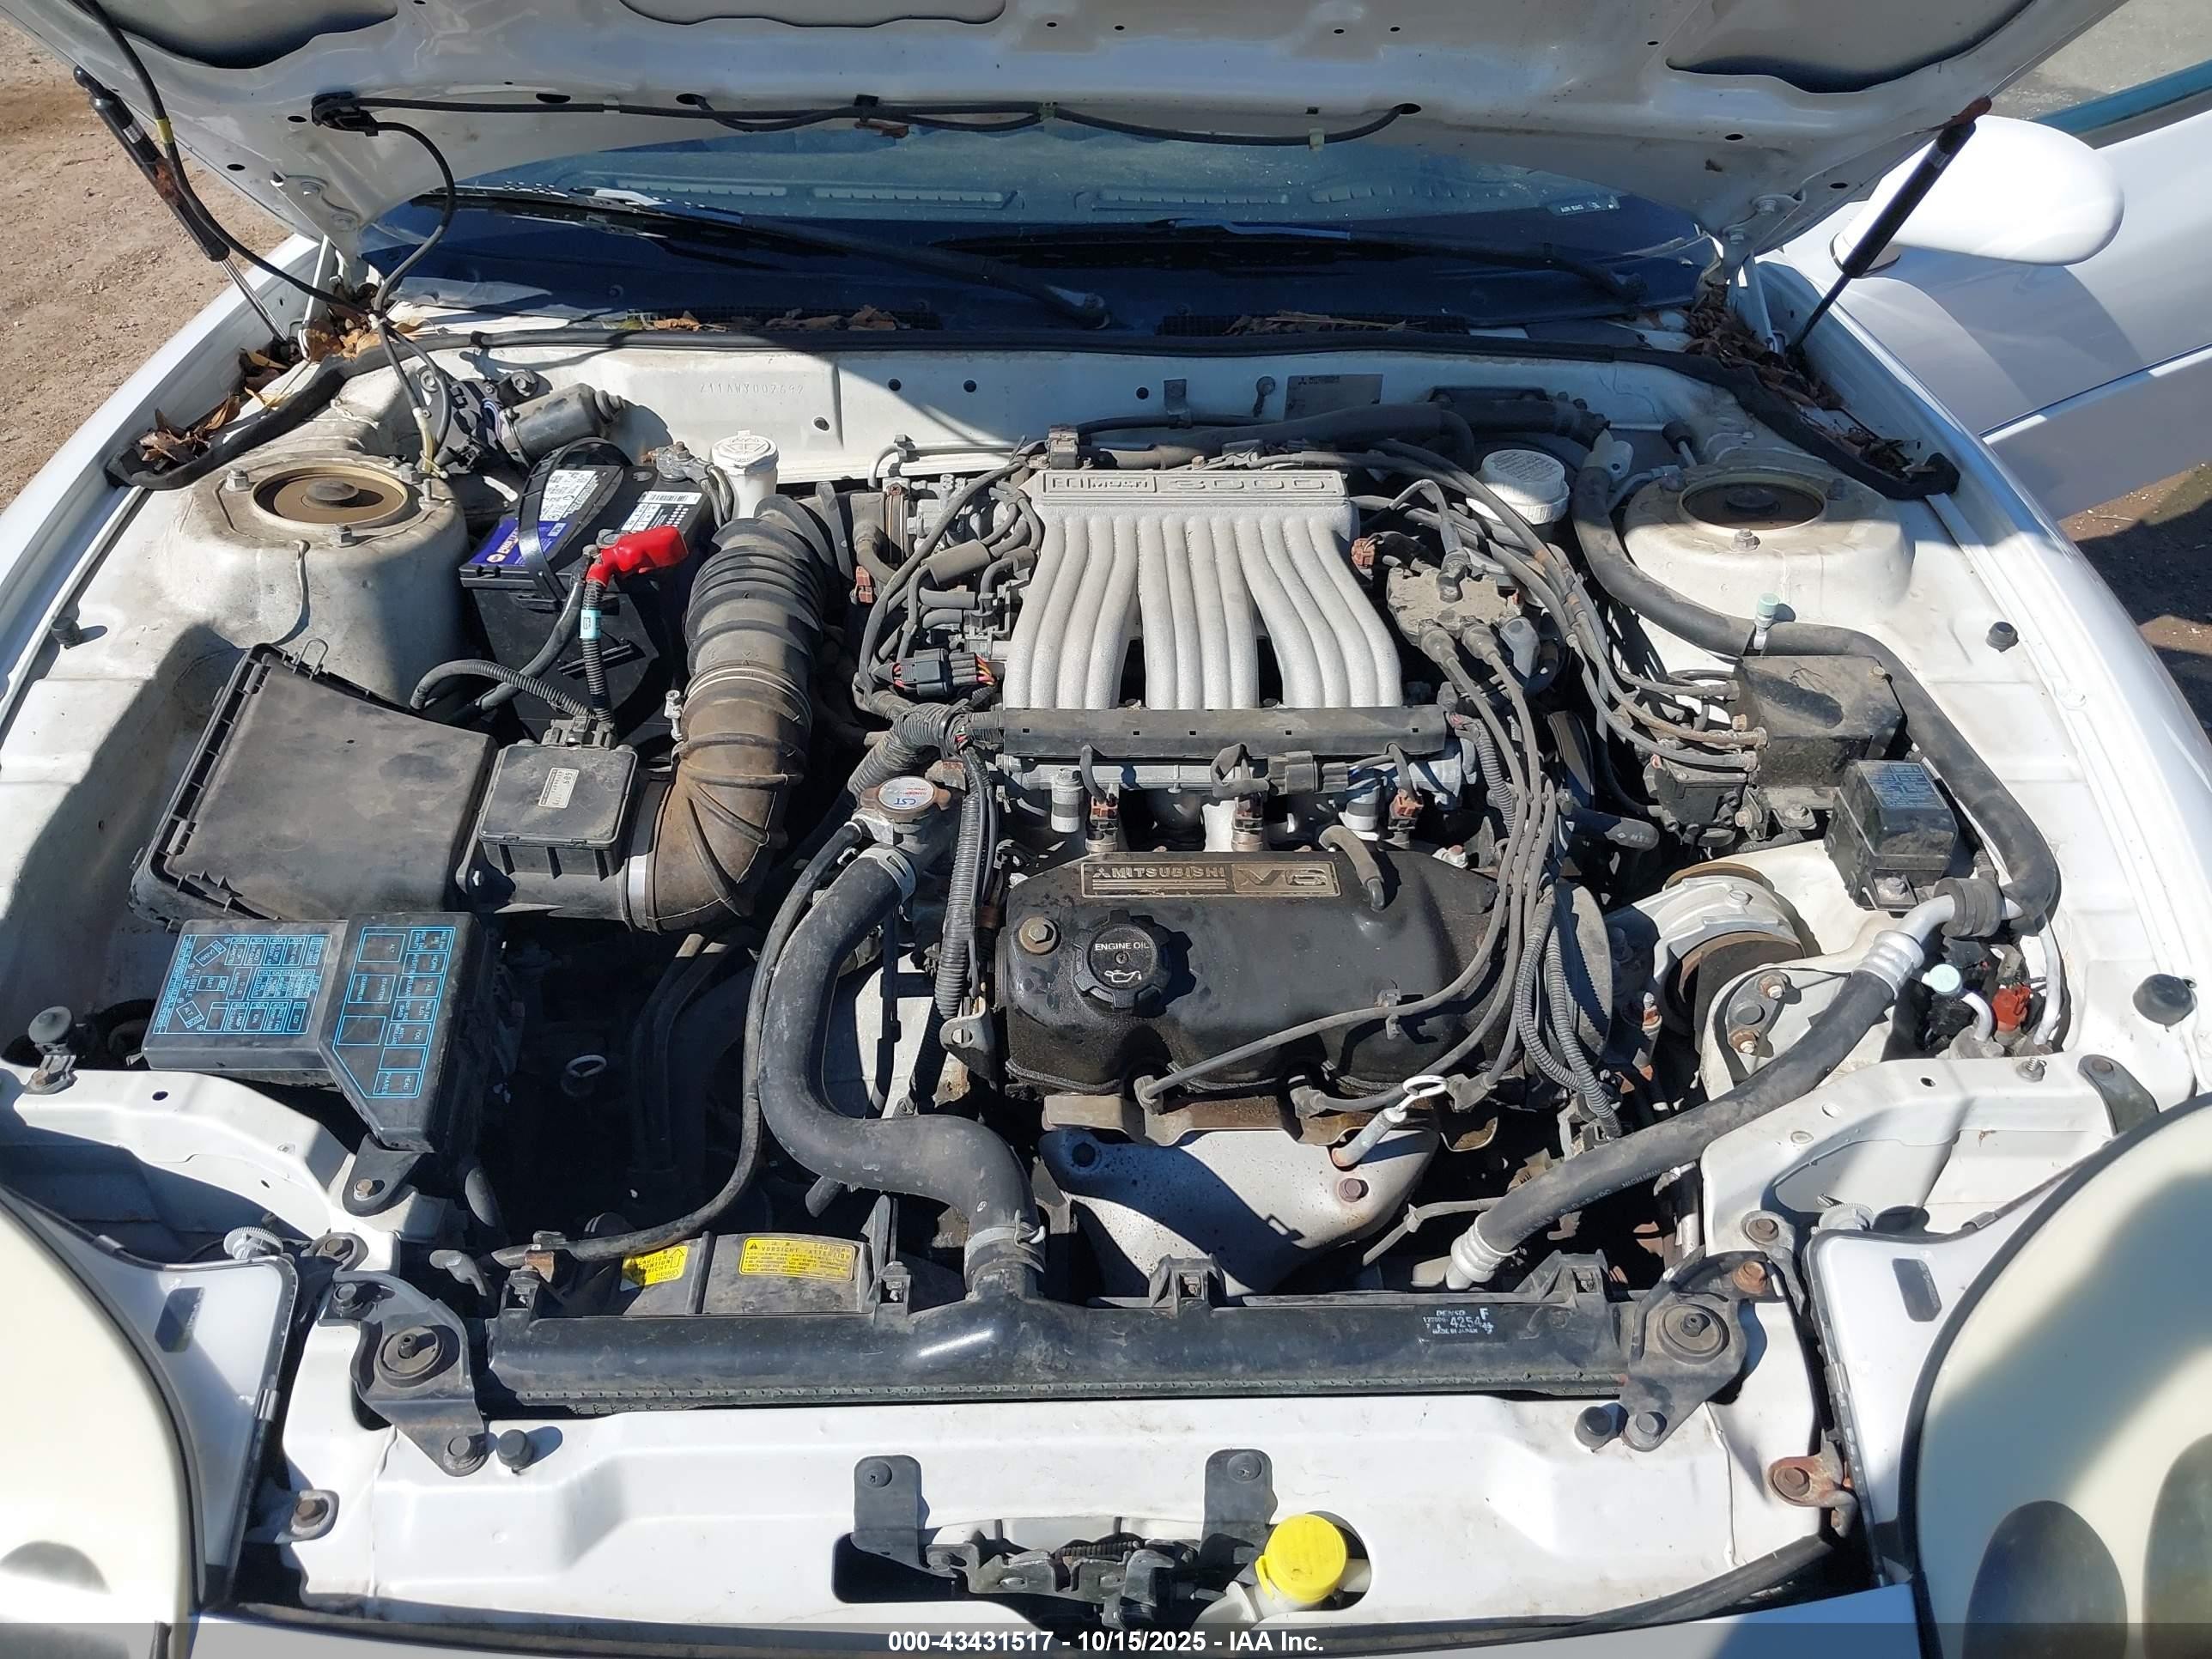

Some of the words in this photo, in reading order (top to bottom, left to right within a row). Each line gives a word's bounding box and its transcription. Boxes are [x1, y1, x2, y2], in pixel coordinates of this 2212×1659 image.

[1174, 479, 1325, 490] 3000
[1111, 865, 1226, 878] MITSUBISHI
[1237, 867, 1328, 887] V6
[1133, 941, 1150, 950] OIL
[430, 954, 439, 971] HORN
[185, 969, 200, 998] FUSIBLE
